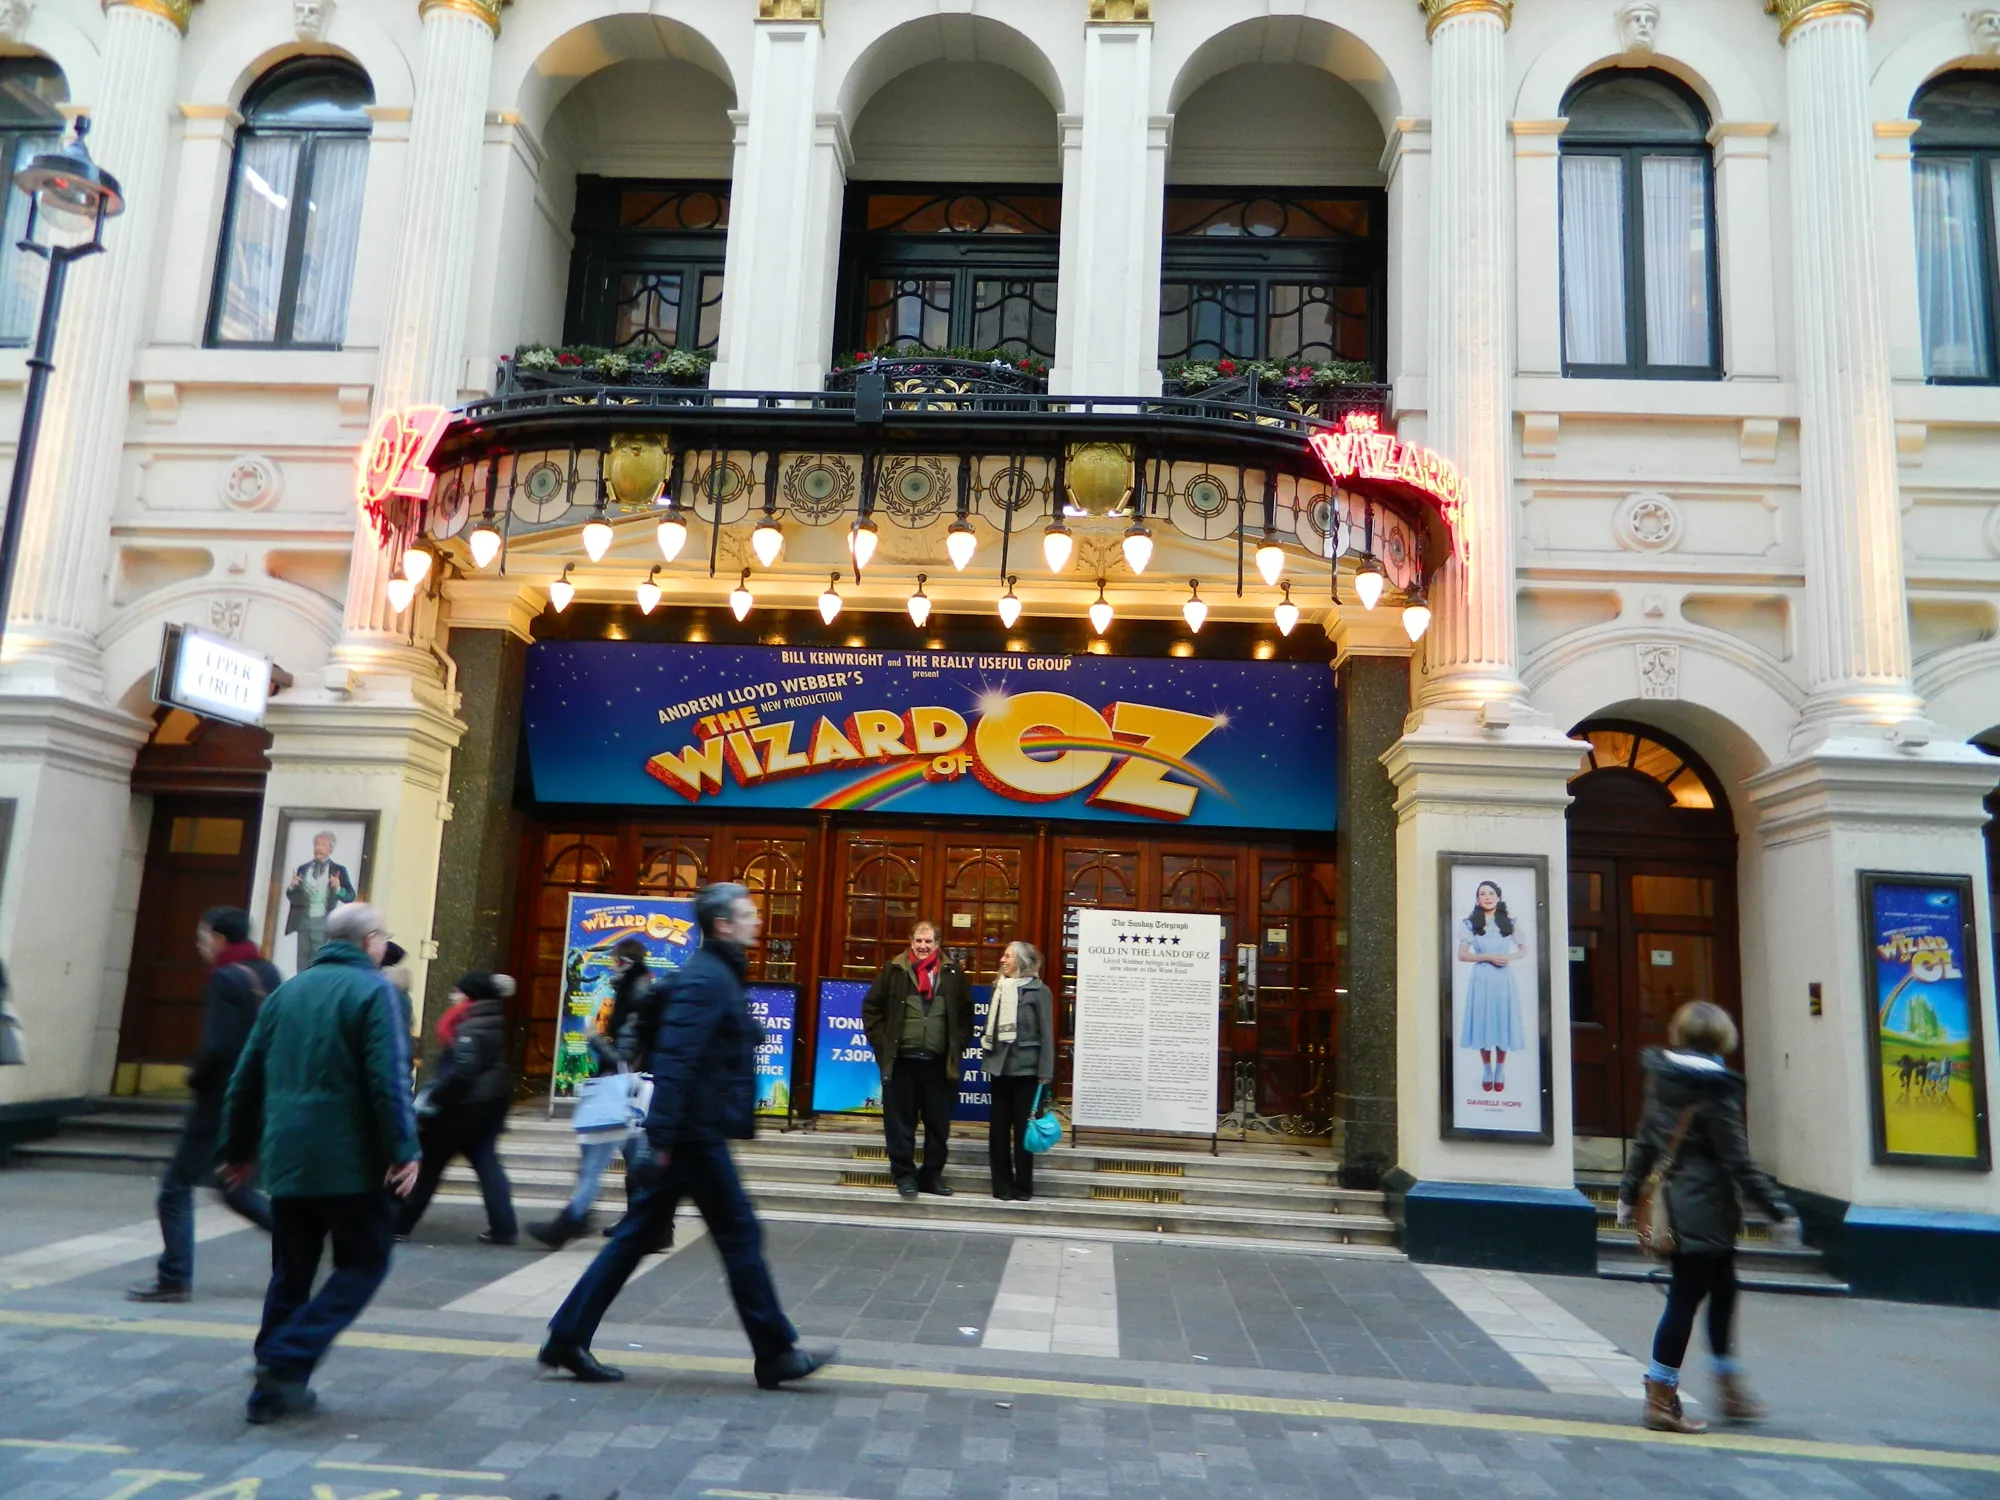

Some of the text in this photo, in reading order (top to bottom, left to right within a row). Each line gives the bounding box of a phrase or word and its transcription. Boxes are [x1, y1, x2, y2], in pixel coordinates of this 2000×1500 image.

[360, 404, 452, 501] OZ
[1308, 433, 1459, 502] WIZARD
[781, 651, 1072, 671] BILL KENWRIGHT and THE REALLY USEFUL GROUP
[912, 669, 940, 679] present
[657, 670, 864, 724] ANDREW LLOYD WEBBER'S
[760, 691, 843, 713] NEW PRODUCTION
[696, 706, 761, 736] THE
[647, 706, 968, 799] WIZARD
[975, 690, 1221, 818] OZ
[928, 755, 974, 779] OF
[581, 914, 647, 933] WIZARD
[646, 913, 695, 946] OZ
[1111, 919, 1189, 930] The Sunday Telegraph
[1088, 946, 1210, 960] GOLD IN THE LAND OF OZ
[828, 1016, 864, 1030] TONI
[963, 1070, 978, 1082] AT
